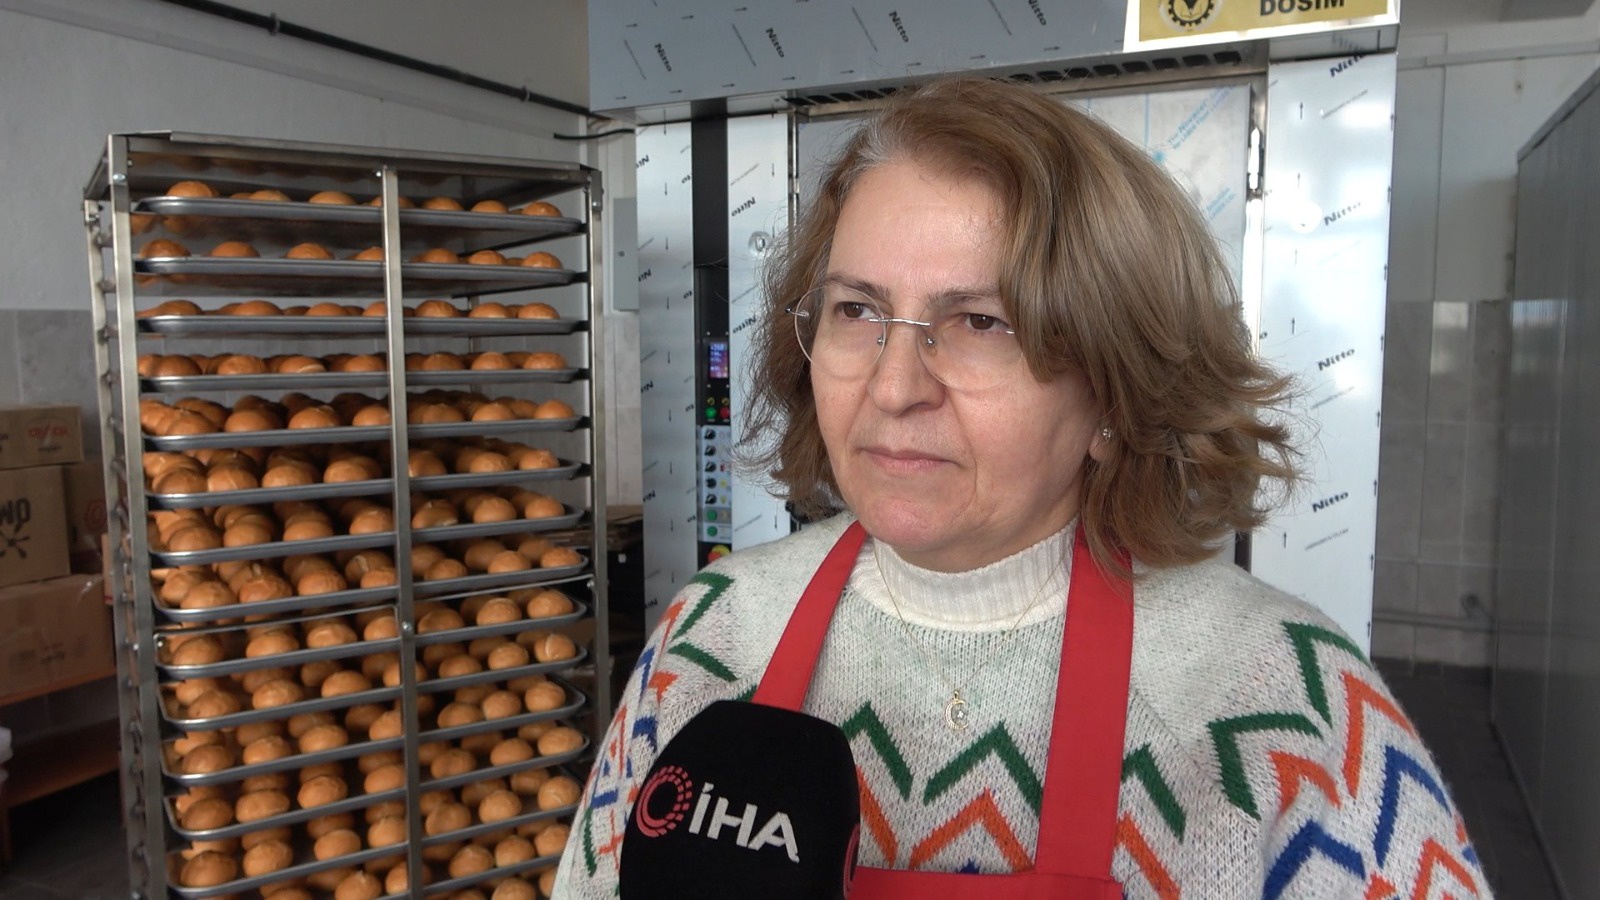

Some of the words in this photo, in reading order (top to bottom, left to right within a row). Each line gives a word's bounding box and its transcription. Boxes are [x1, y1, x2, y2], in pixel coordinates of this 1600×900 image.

[889, 10, 909, 43] Nitto
[765, 27, 785, 58] Nitto
[654, 43, 672, 72] Nitto
[731, 196, 756, 217] Nitto
[1317, 348, 1355, 371] Nitto
[1312, 491, 1349, 513] Nitto
[688, 782, 800, 863] İHA
